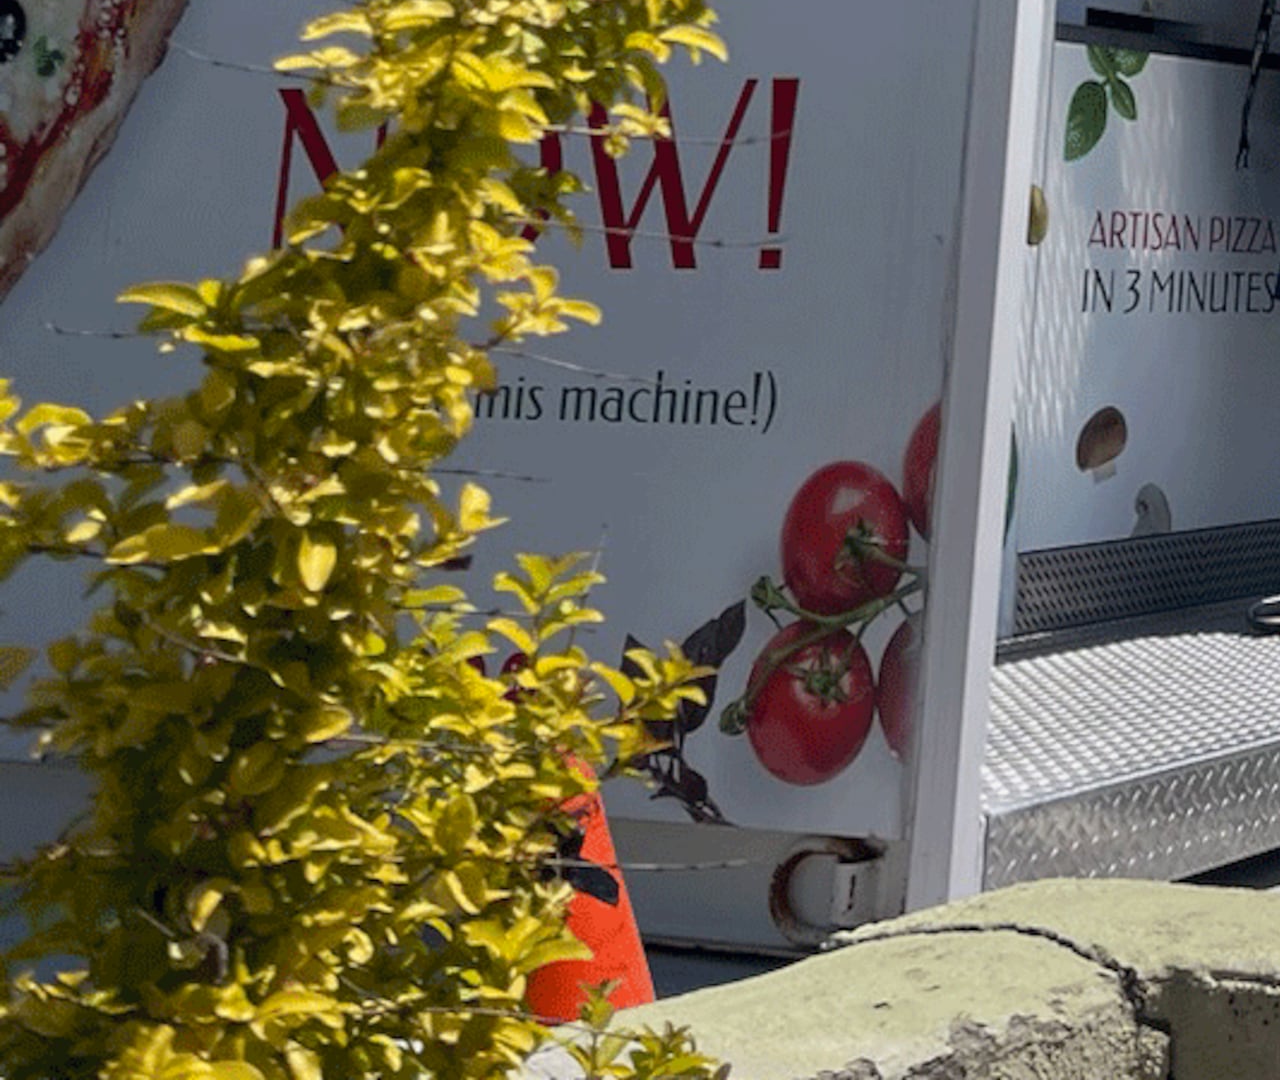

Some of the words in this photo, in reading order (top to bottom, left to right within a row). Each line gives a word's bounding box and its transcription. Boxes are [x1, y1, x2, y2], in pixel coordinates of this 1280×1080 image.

[273, 78, 800, 269] NW!
[1087, 209, 1199, 252] ARTISAN
[1208, 216, 1277, 254] PIZZA
[1081, 269, 1115, 313] IN
[1123, 270, 1141, 314] 3
[1149, 270, 1278, 314] MINUTES
[558, 369, 779, 432] machine!)
